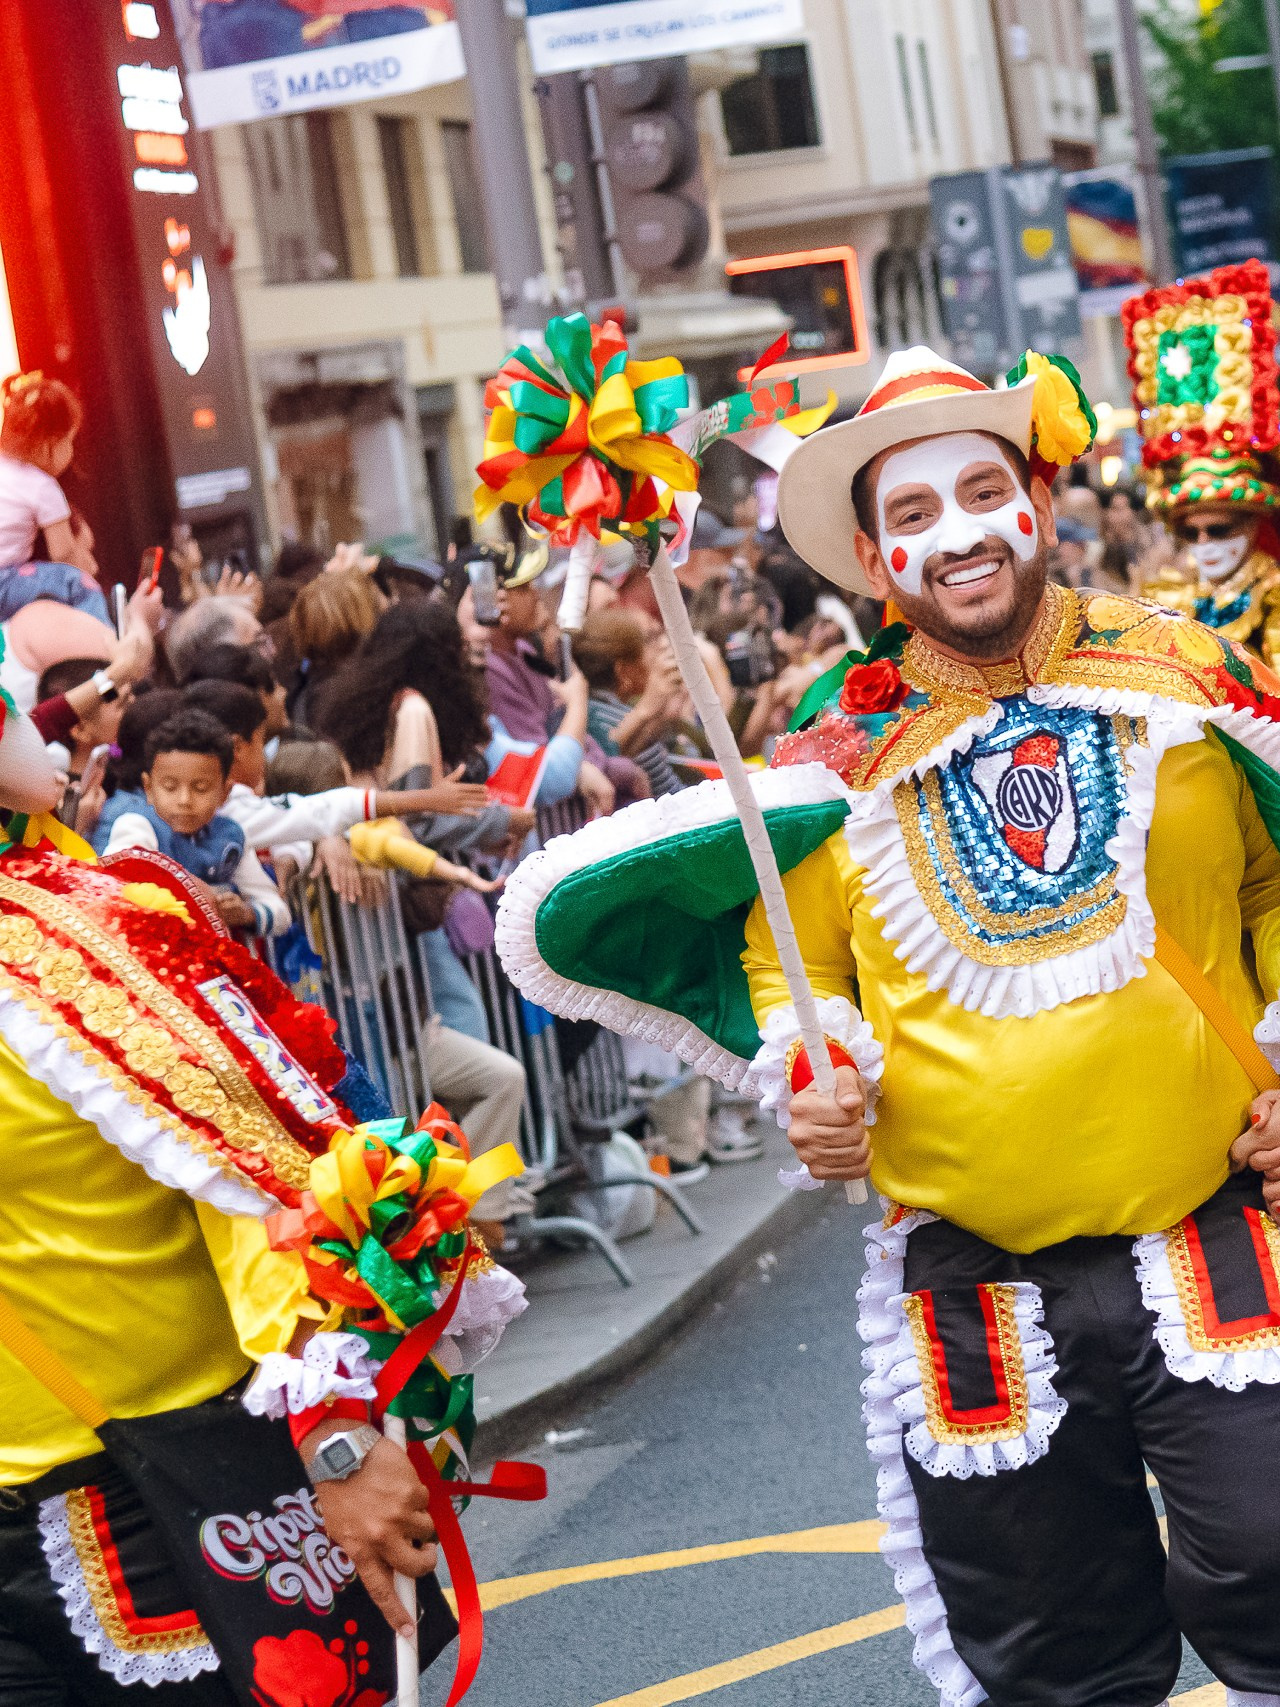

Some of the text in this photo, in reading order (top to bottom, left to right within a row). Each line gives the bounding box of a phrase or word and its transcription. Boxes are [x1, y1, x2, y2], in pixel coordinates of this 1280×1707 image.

[286, 56, 402, 97] MADRID
[1002, 767, 1057, 828] CARP
[201, 1488, 325, 1578] Cipot
